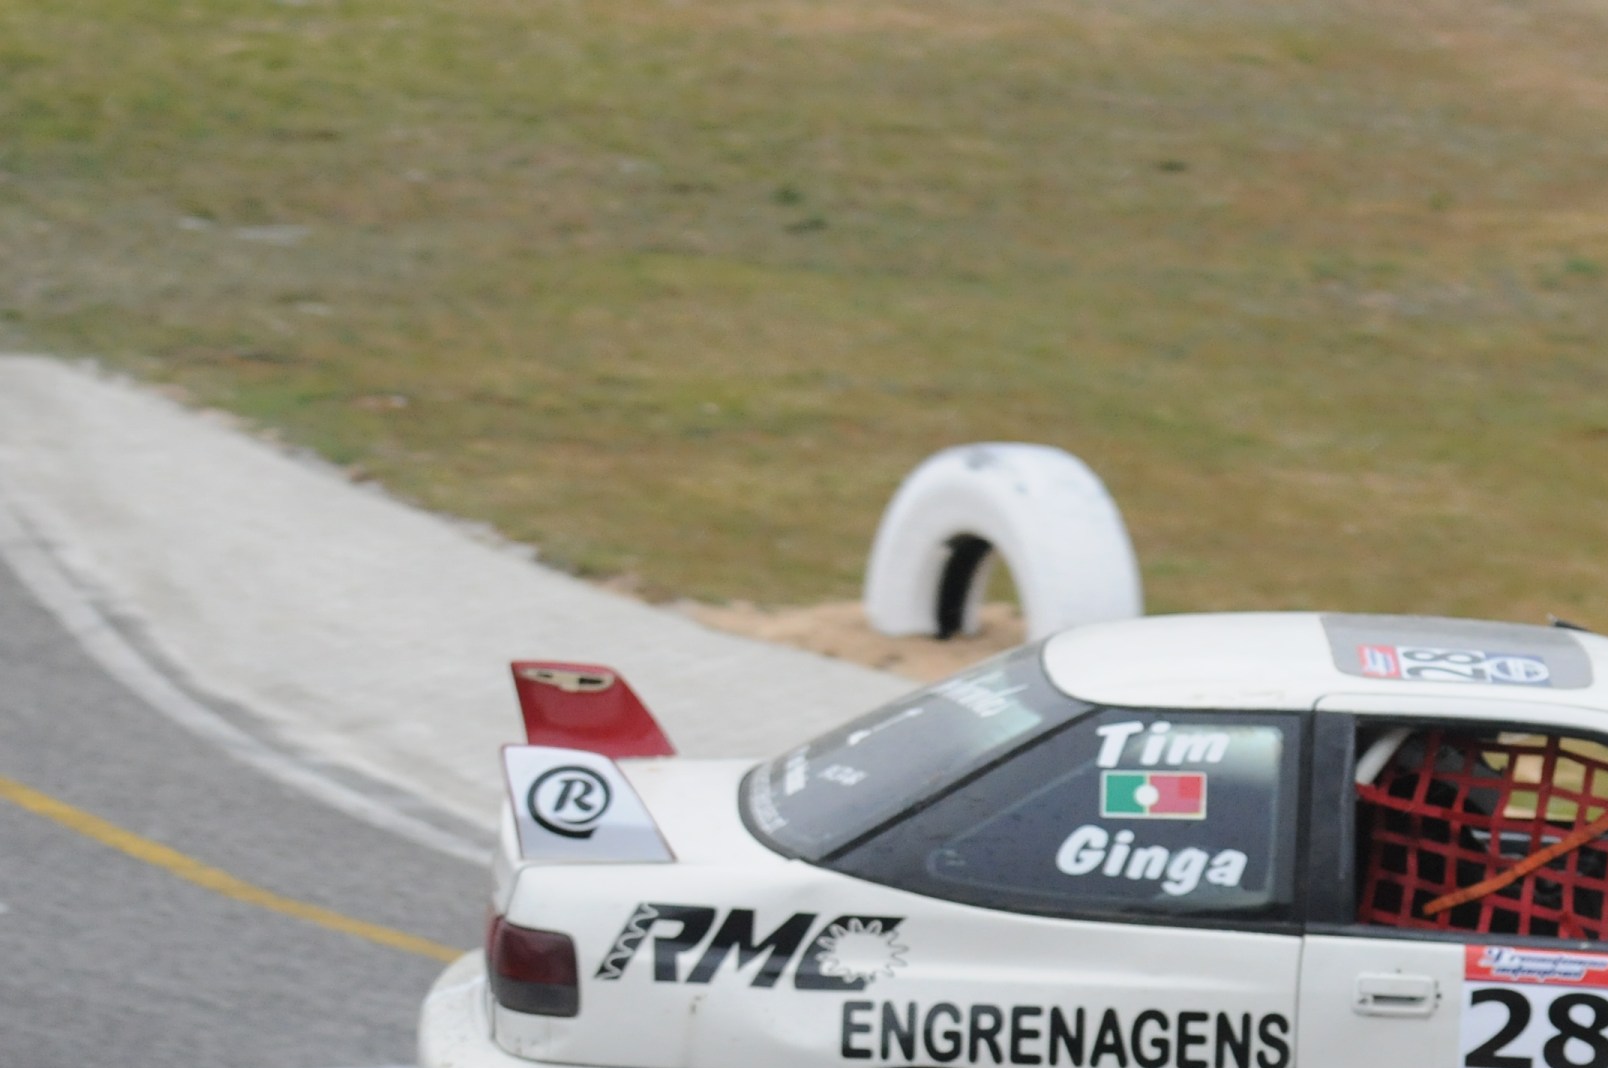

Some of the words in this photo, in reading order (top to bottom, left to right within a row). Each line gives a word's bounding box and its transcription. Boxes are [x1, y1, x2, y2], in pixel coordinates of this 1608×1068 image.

[1402, 650, 1486, 680] 28
[1095, 720, 1230, 769] Tim
[1056, 824, 1248, 896] Ginga
